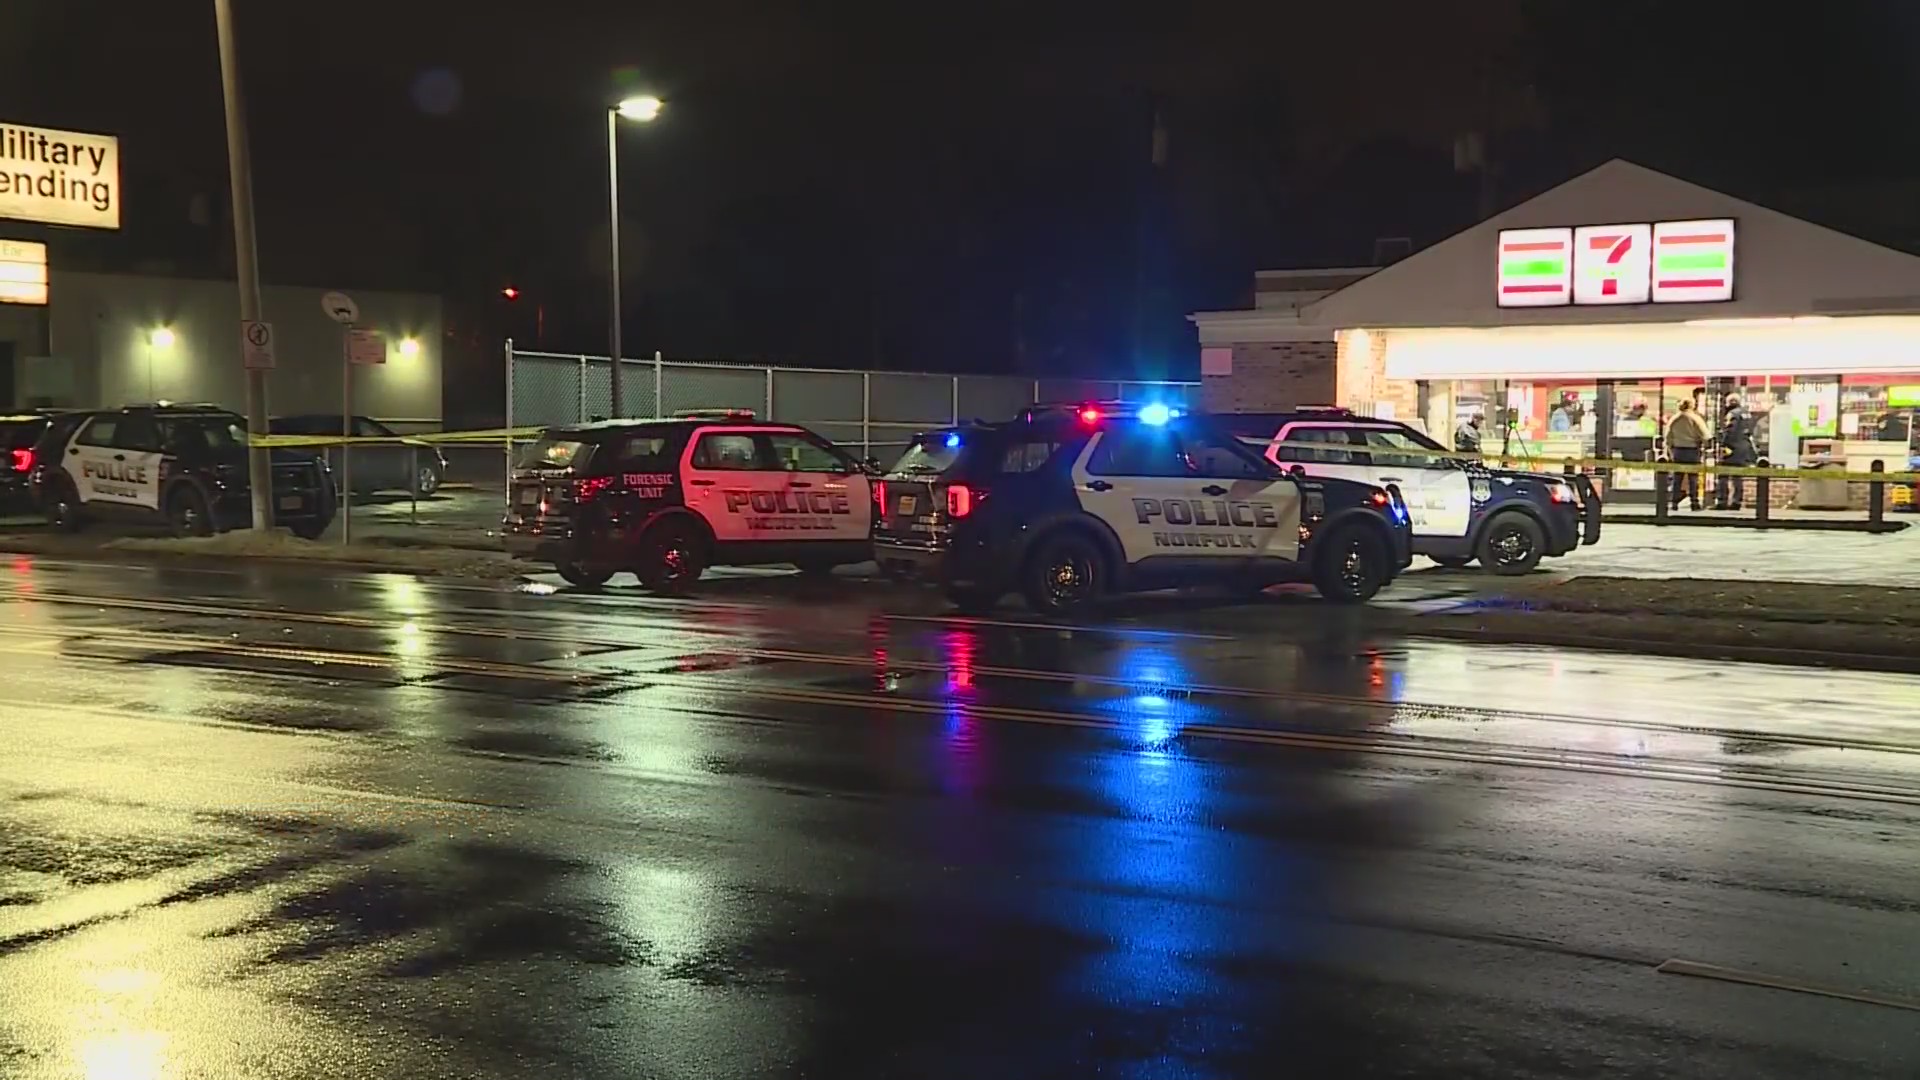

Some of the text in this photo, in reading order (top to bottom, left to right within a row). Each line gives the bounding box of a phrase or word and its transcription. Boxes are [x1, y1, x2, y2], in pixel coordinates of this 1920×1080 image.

[0, 128, 105, 176] ilitary
[1589, 235, 1633, 295] 7
[82, 461, 148, 485] POLICE
[623, 473, 673, 485] FORENSIC
[633, 487, 664, 498] UNIT
[722, 490, 850, 514] POLICE
[1132, 498, 1278, 528] POLICE
[1153, 532, 1257, 548] NORFOLK
